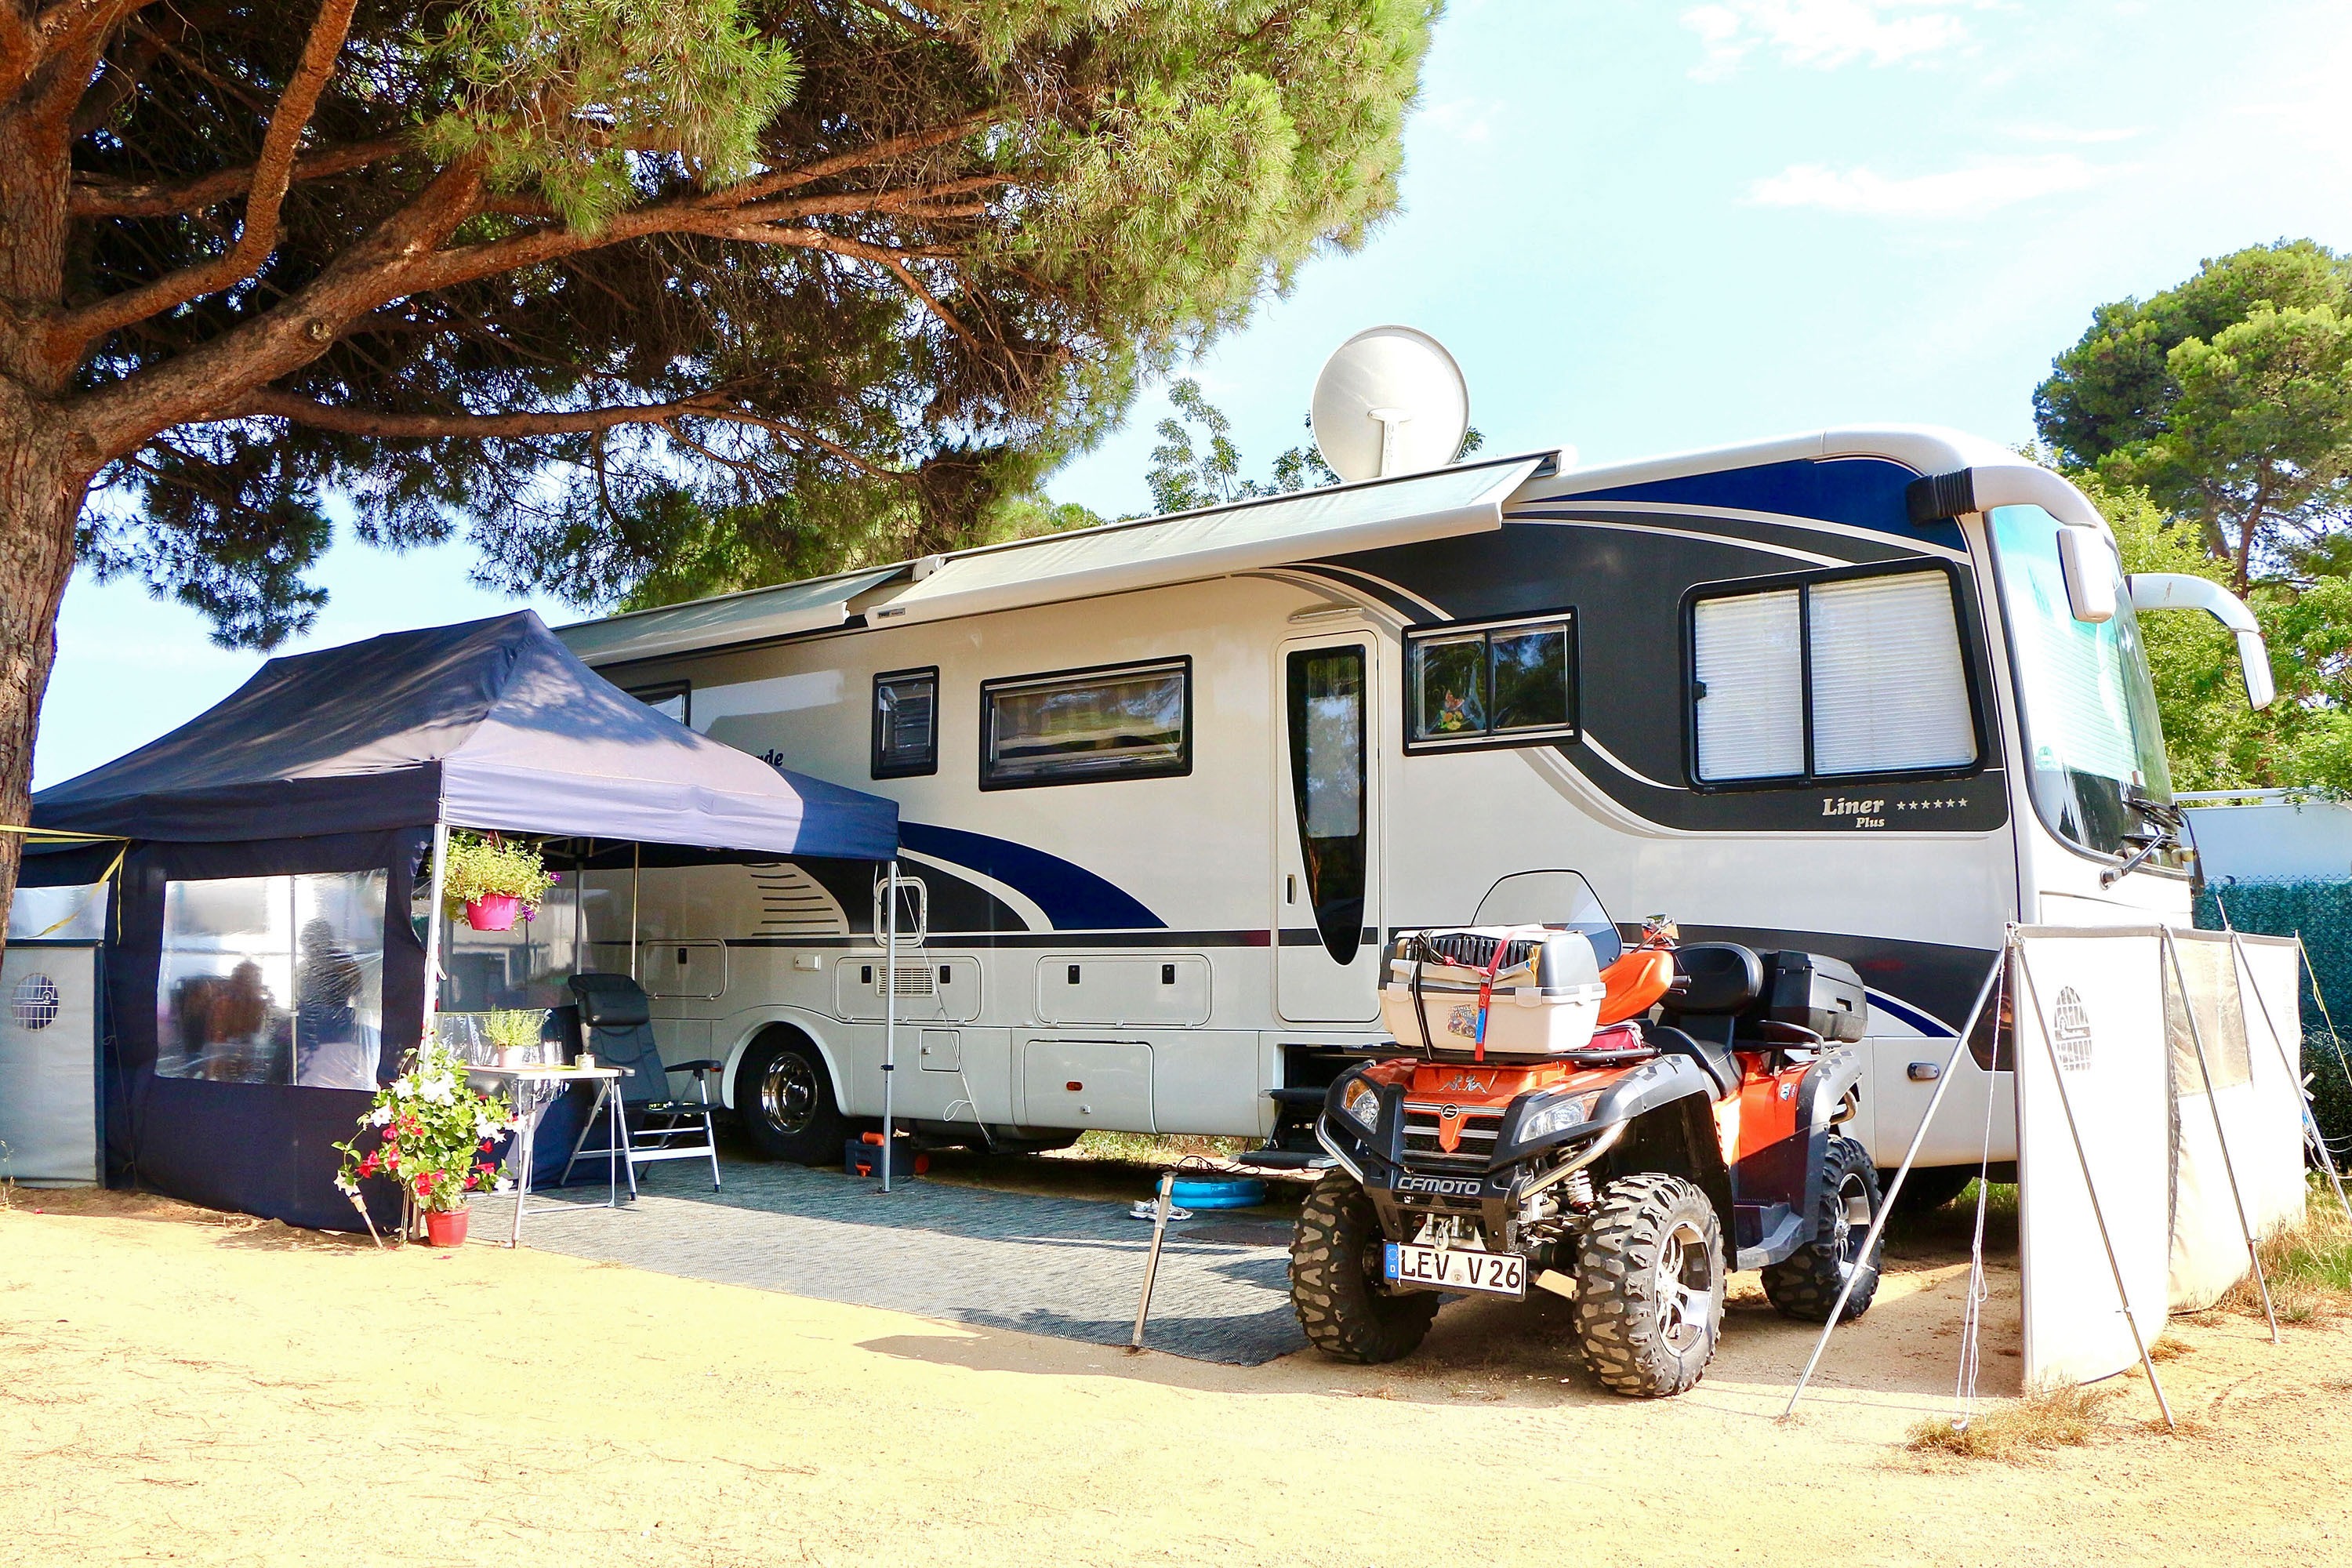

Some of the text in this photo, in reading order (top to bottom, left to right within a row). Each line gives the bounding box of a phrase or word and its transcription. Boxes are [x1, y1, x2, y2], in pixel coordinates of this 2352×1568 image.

[1822, 797, 1885, 816] Liner
[1855, 817, 1885, 829] Plus
[1397, 1176, 1481, 1195] CFMOTO
[1390, 1265, 1396, 1273] D
[1401, 1250, 1521, 1288] LEV V 26
